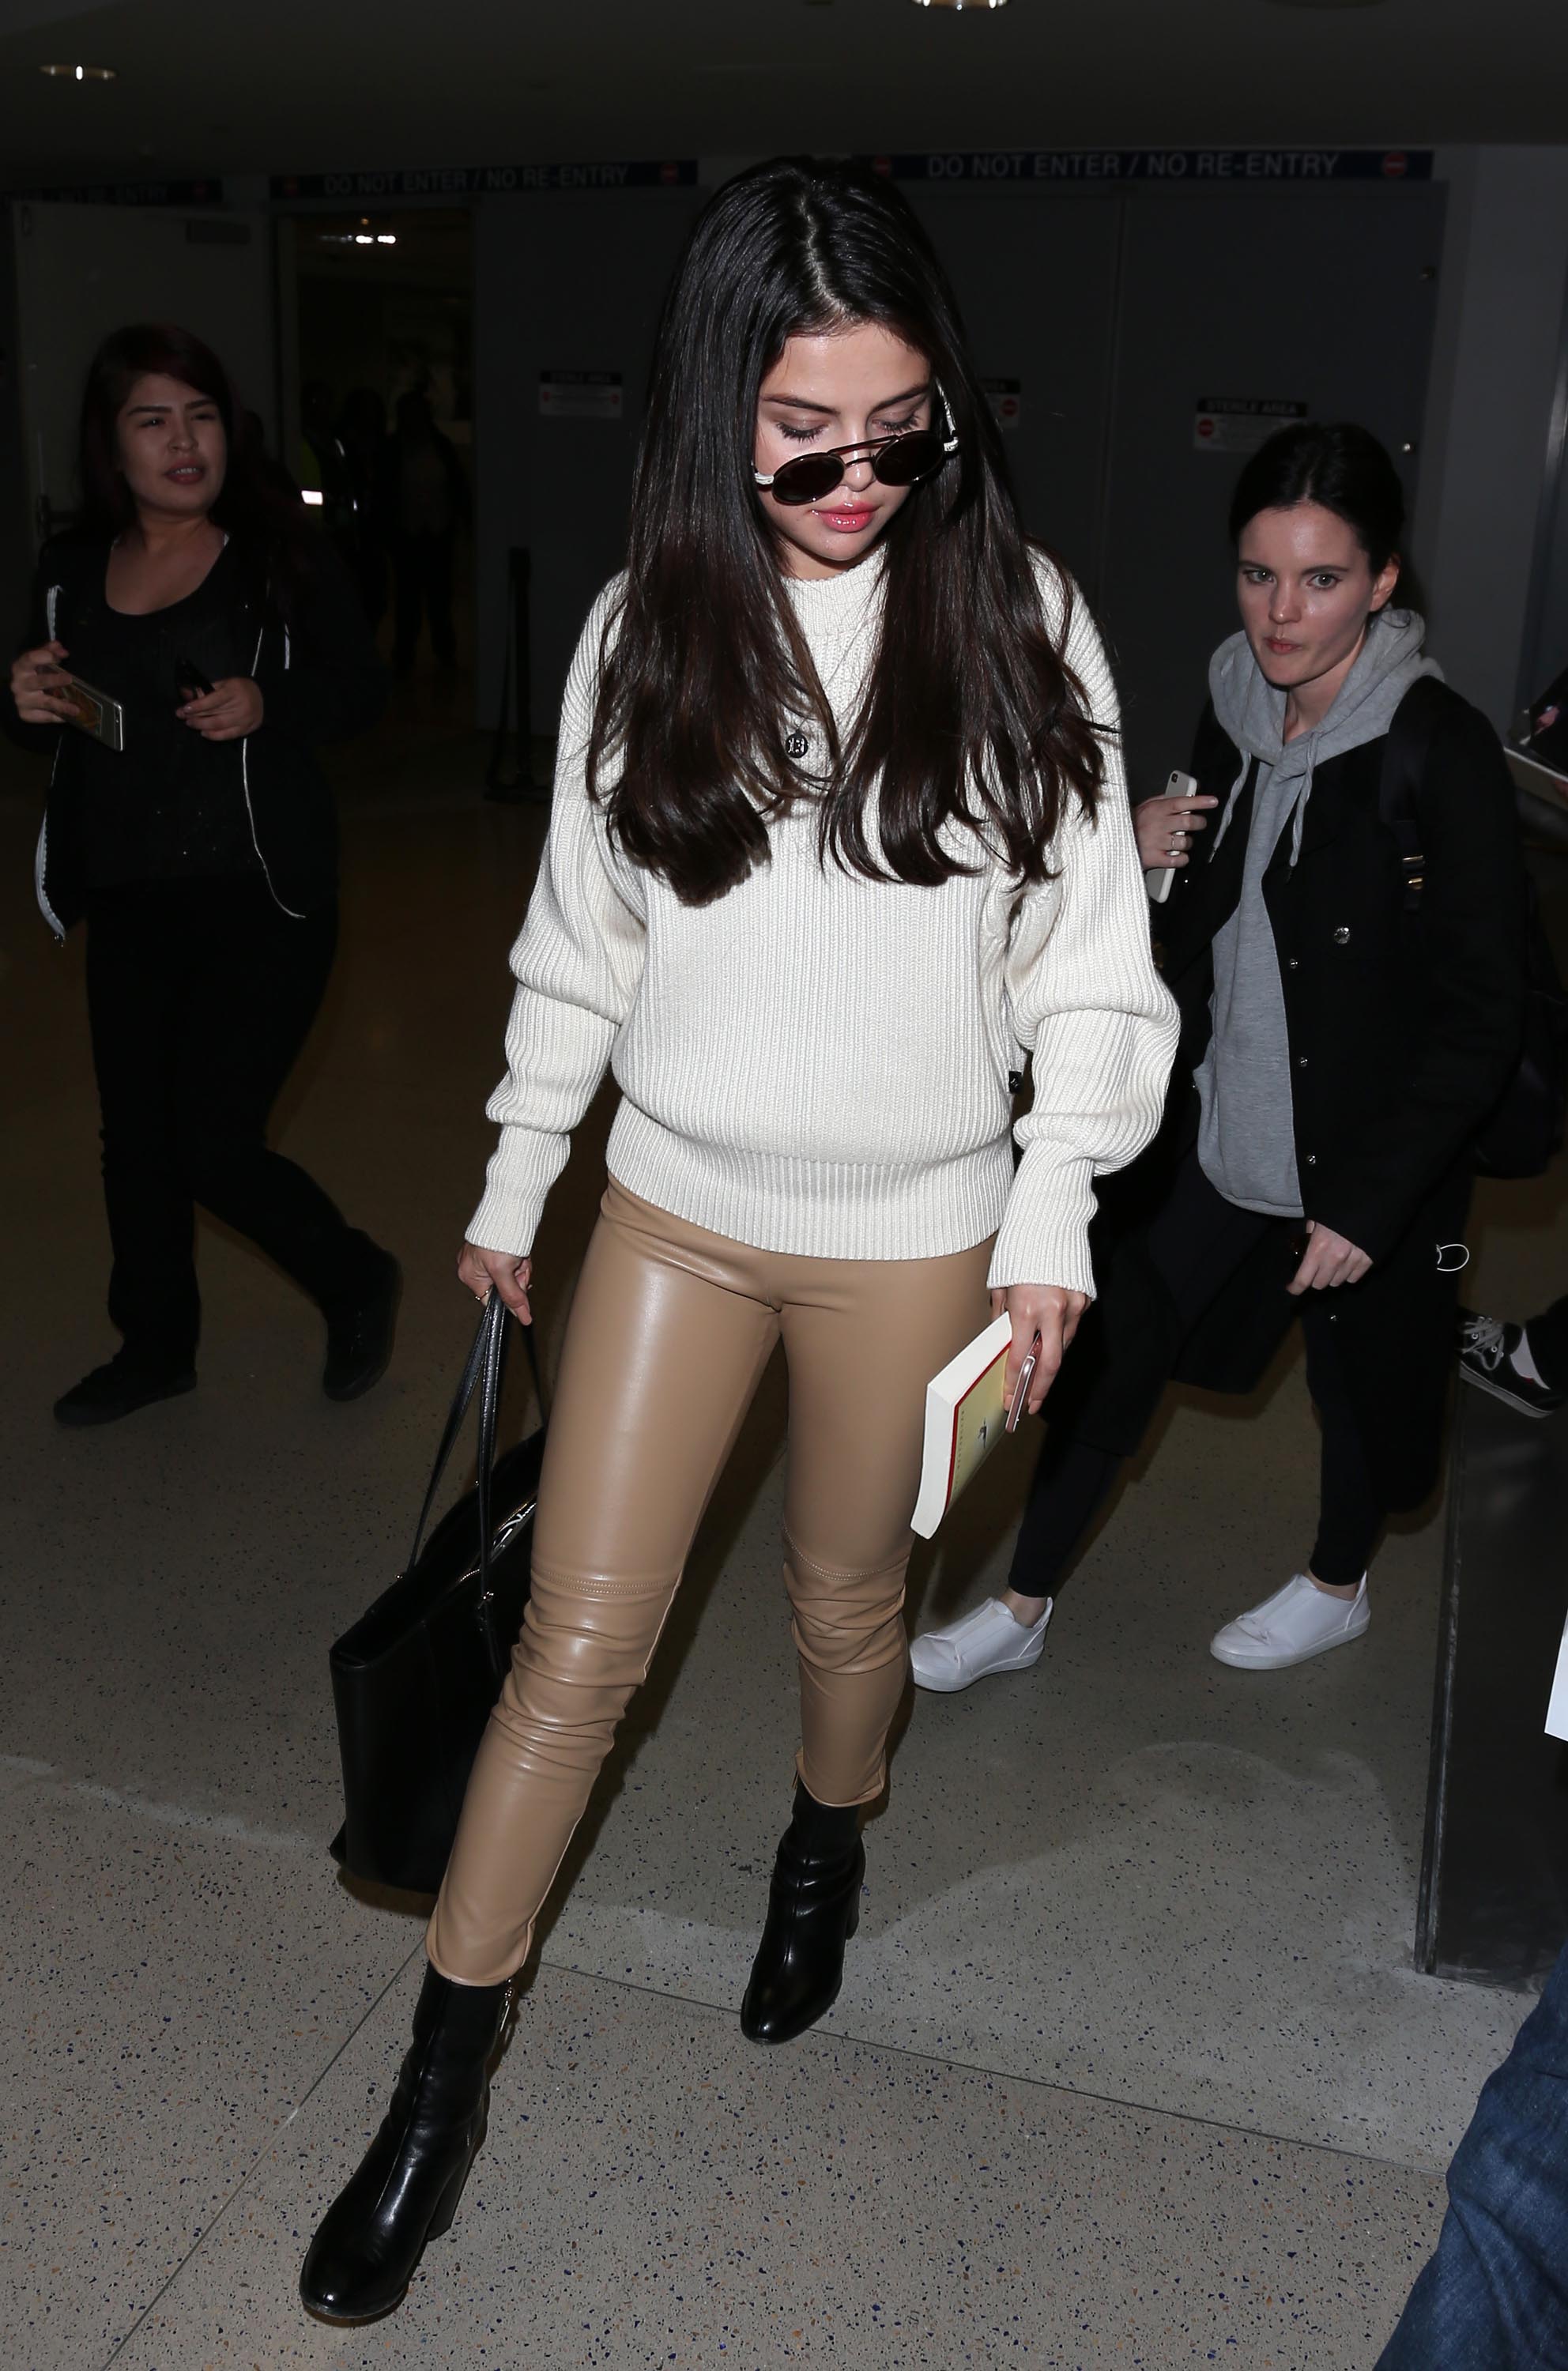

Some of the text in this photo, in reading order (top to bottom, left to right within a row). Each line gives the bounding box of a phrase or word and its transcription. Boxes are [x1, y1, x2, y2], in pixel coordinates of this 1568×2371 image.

[324, 174, 352, 195] DO
[358, 172, 395, 194] NOT
[402, 168, 467, 192] ENTER
[487, 165, 517, 188] NO
[522, 163, 629, 187] RE-ENTRY
[928, 152, 1340, 178] DO NOT ENTER / NO RE-ENTRY
